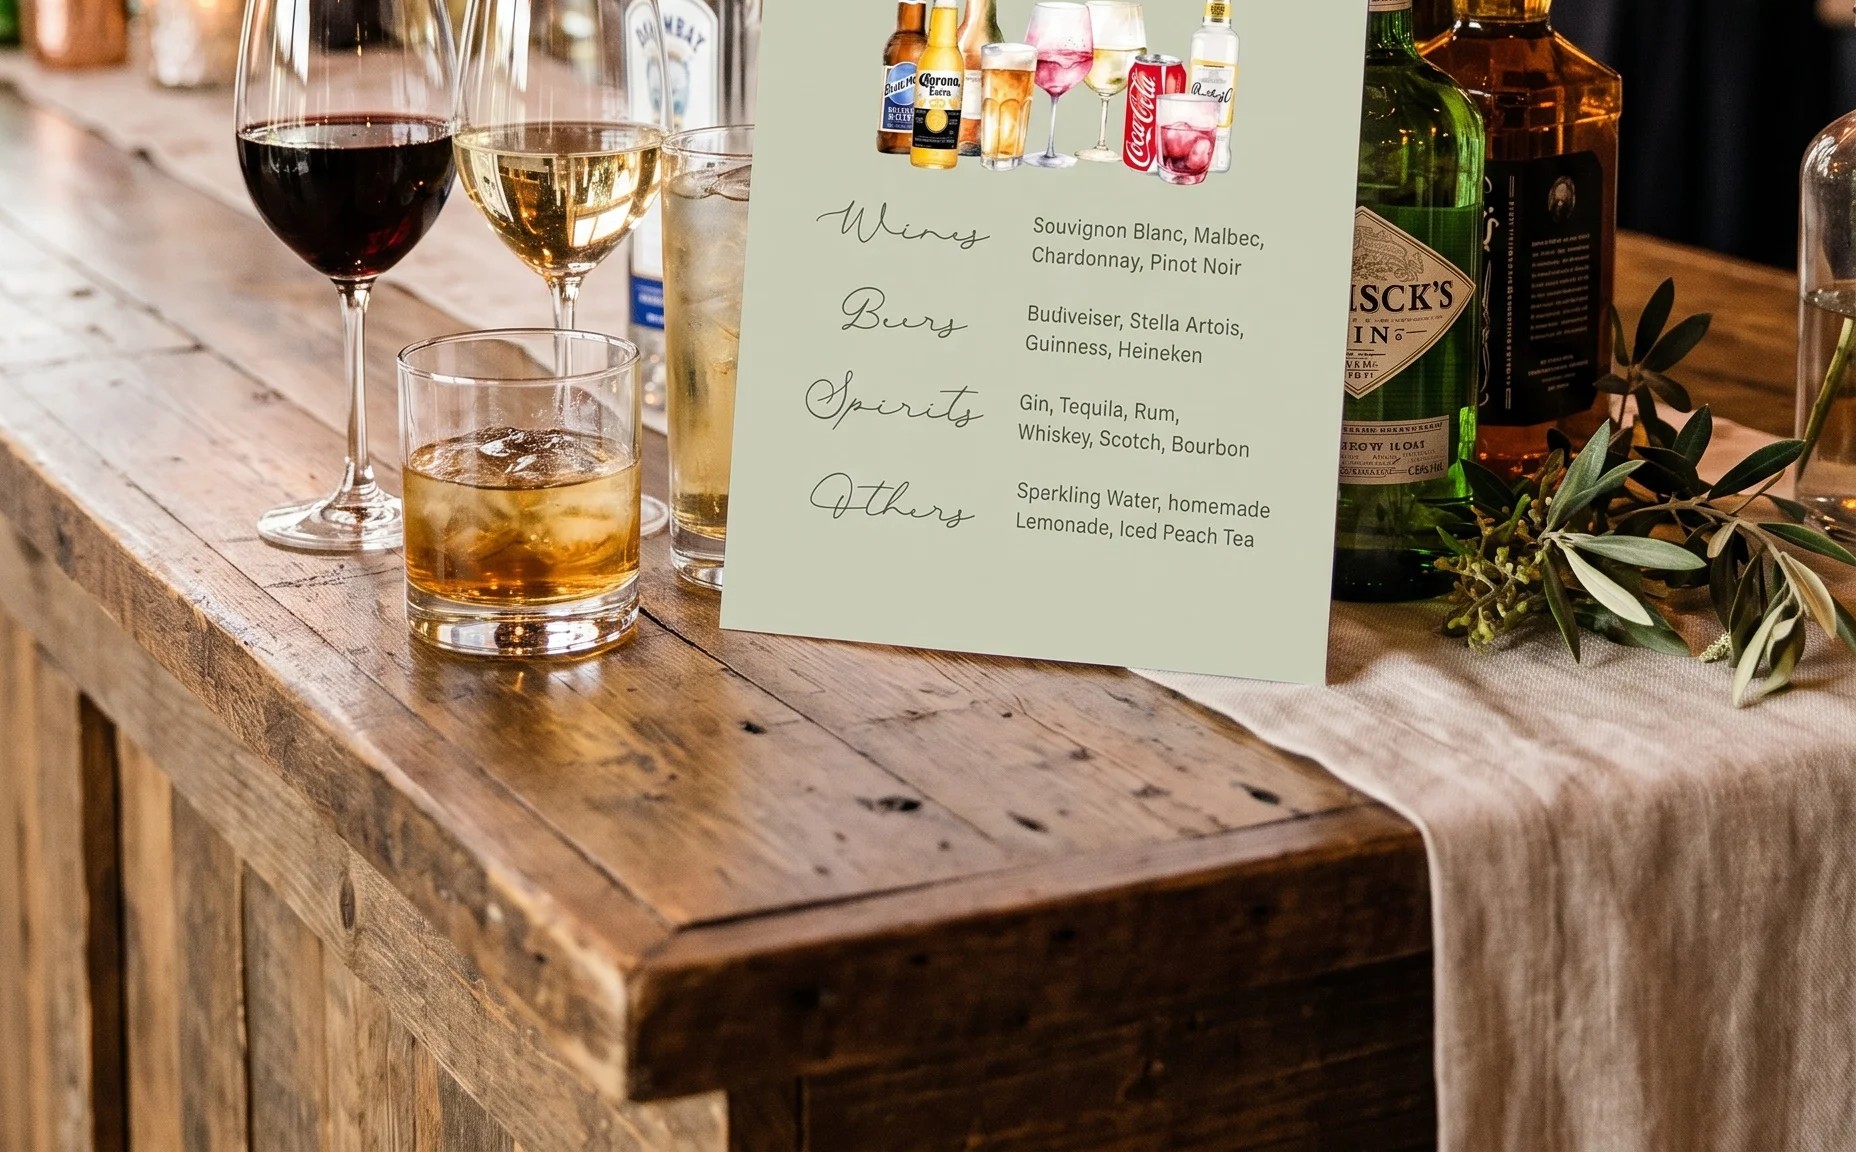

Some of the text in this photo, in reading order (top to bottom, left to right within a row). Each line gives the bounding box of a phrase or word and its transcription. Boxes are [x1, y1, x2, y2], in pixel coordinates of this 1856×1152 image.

[815, 199, 991, 250] Wines
[1033, 216, 1265, 251] Souvignon Blanc, Malbec,
[1032, 245, 1243, 276] Chardonnay, Pinot Noir
[841, 286, 969, 339] Beers
[1129, 311, 1180, 333] Stella
[1184, 316, 1244, 340] Artois,
[1025, 334, 1202, 364] Guinness, Heineken
[804, 369, 985, 431] Spirits
[1019, 393, 1180, 426] Gin, Tequila, Rum,
[1018, 422, 1250, 458] Whiskey, Scotch, Bourbon
[809, 472, 976, 529] Others
[1016, 481, 1271, 519] Sperkling Water, homemade
[1016, 511, 1255, 548] Lemonade, Iced Peach Tea
